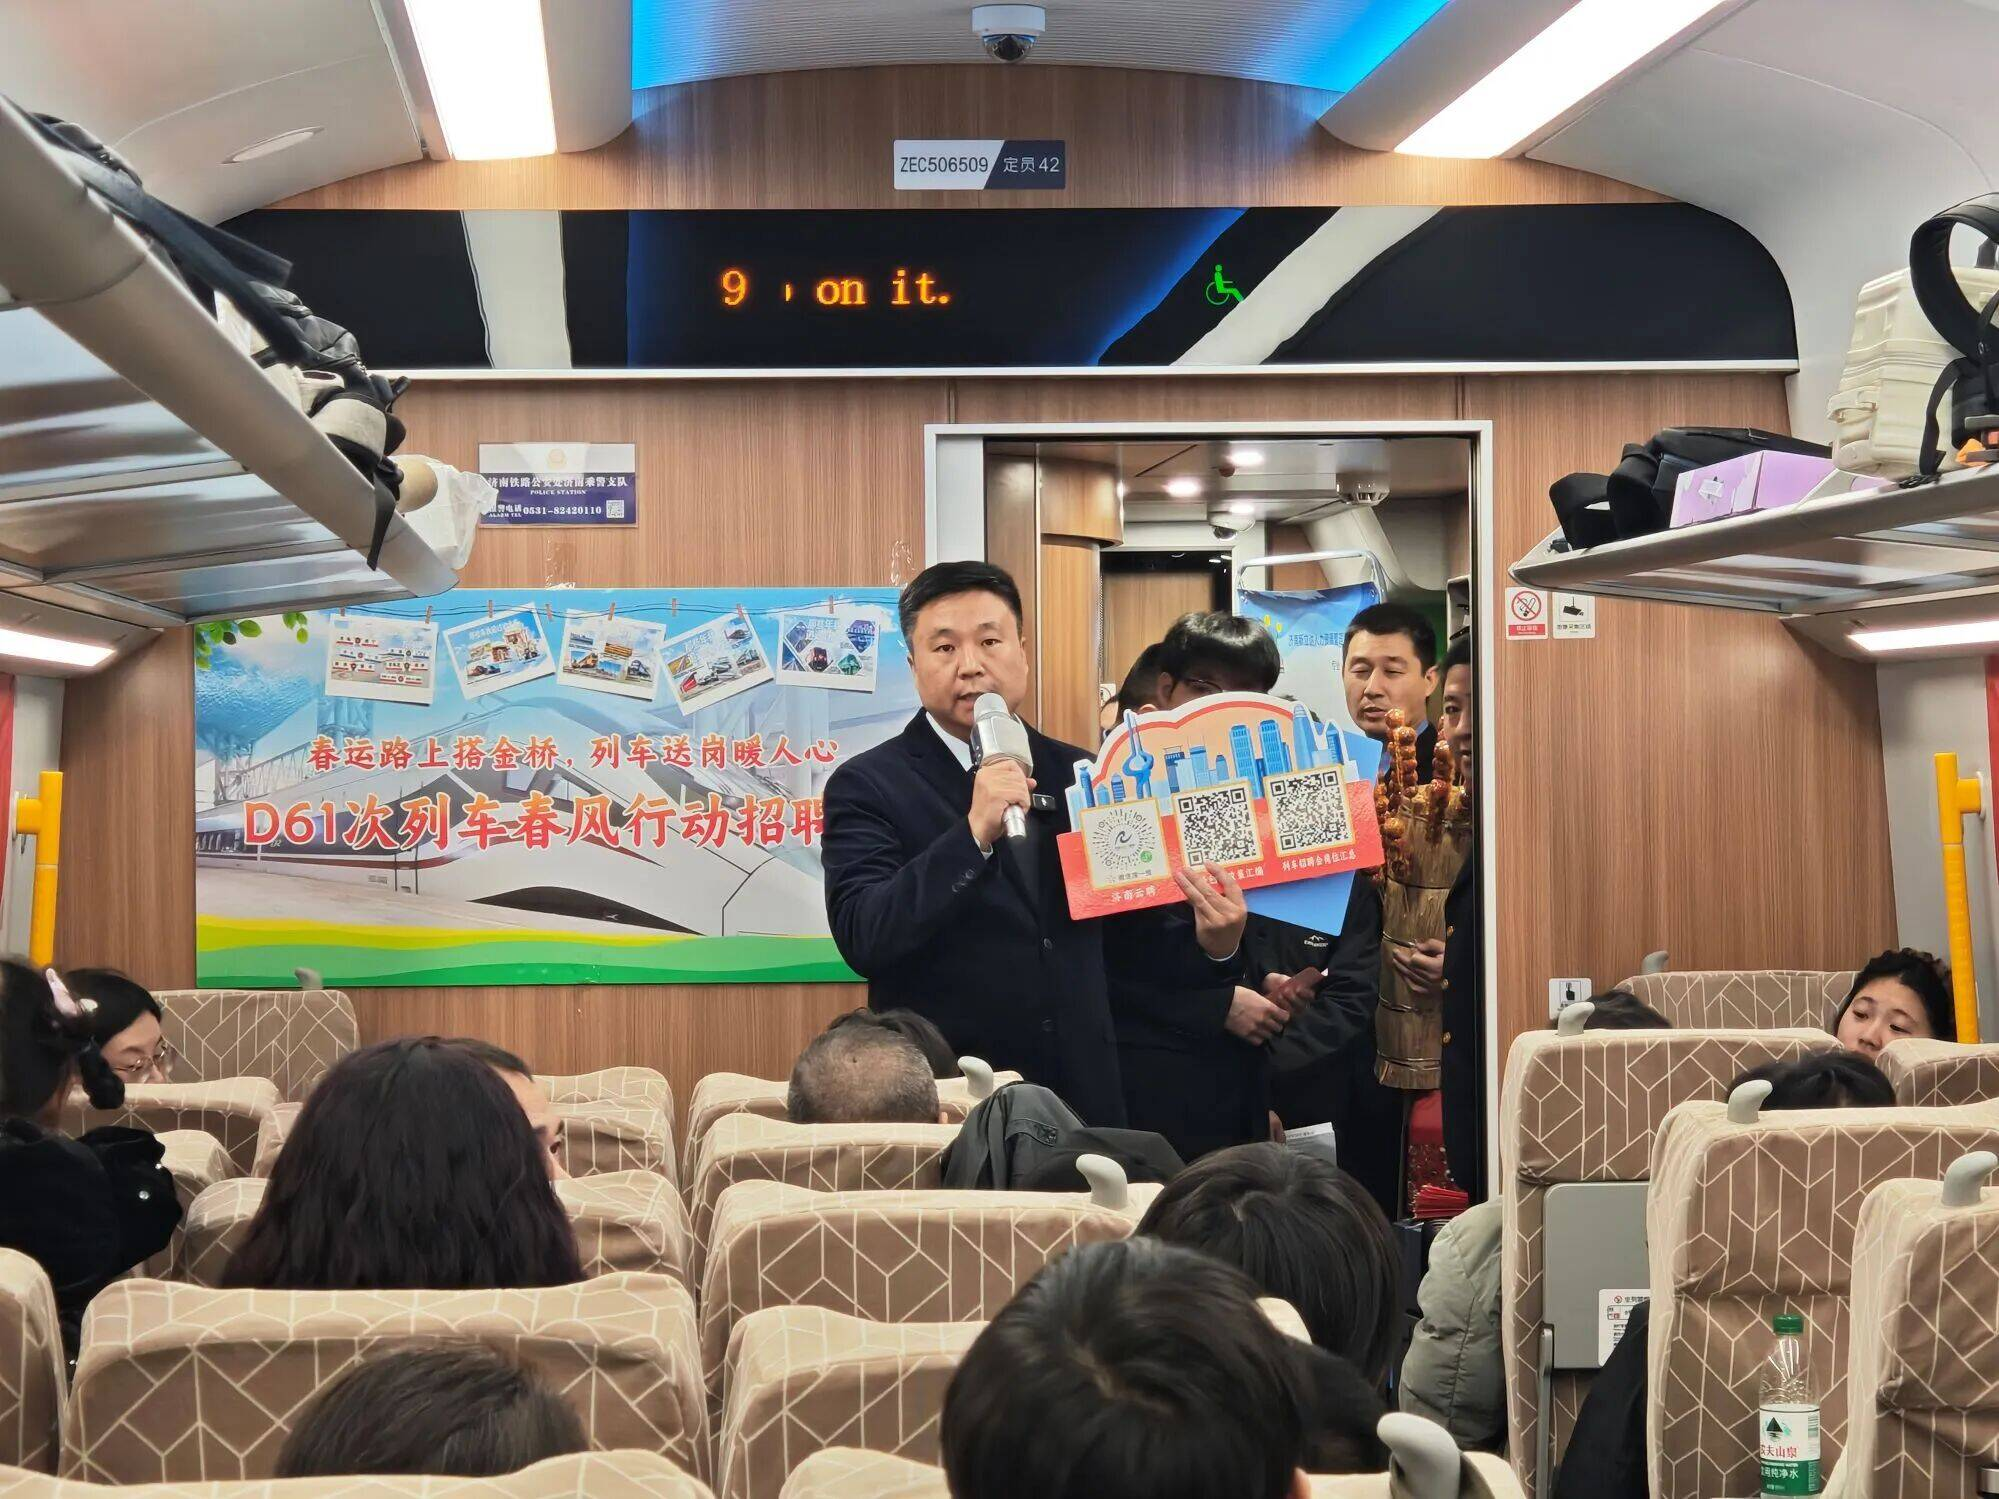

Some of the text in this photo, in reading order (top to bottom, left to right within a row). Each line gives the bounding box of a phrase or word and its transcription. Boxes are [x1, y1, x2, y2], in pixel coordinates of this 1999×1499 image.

[900, 157, 989, 173] ZEC506509
[816, 279, 866, 305] on
[891, 269, 950, 305] it.
[523, 506, 602, 515] 0531-82420110
